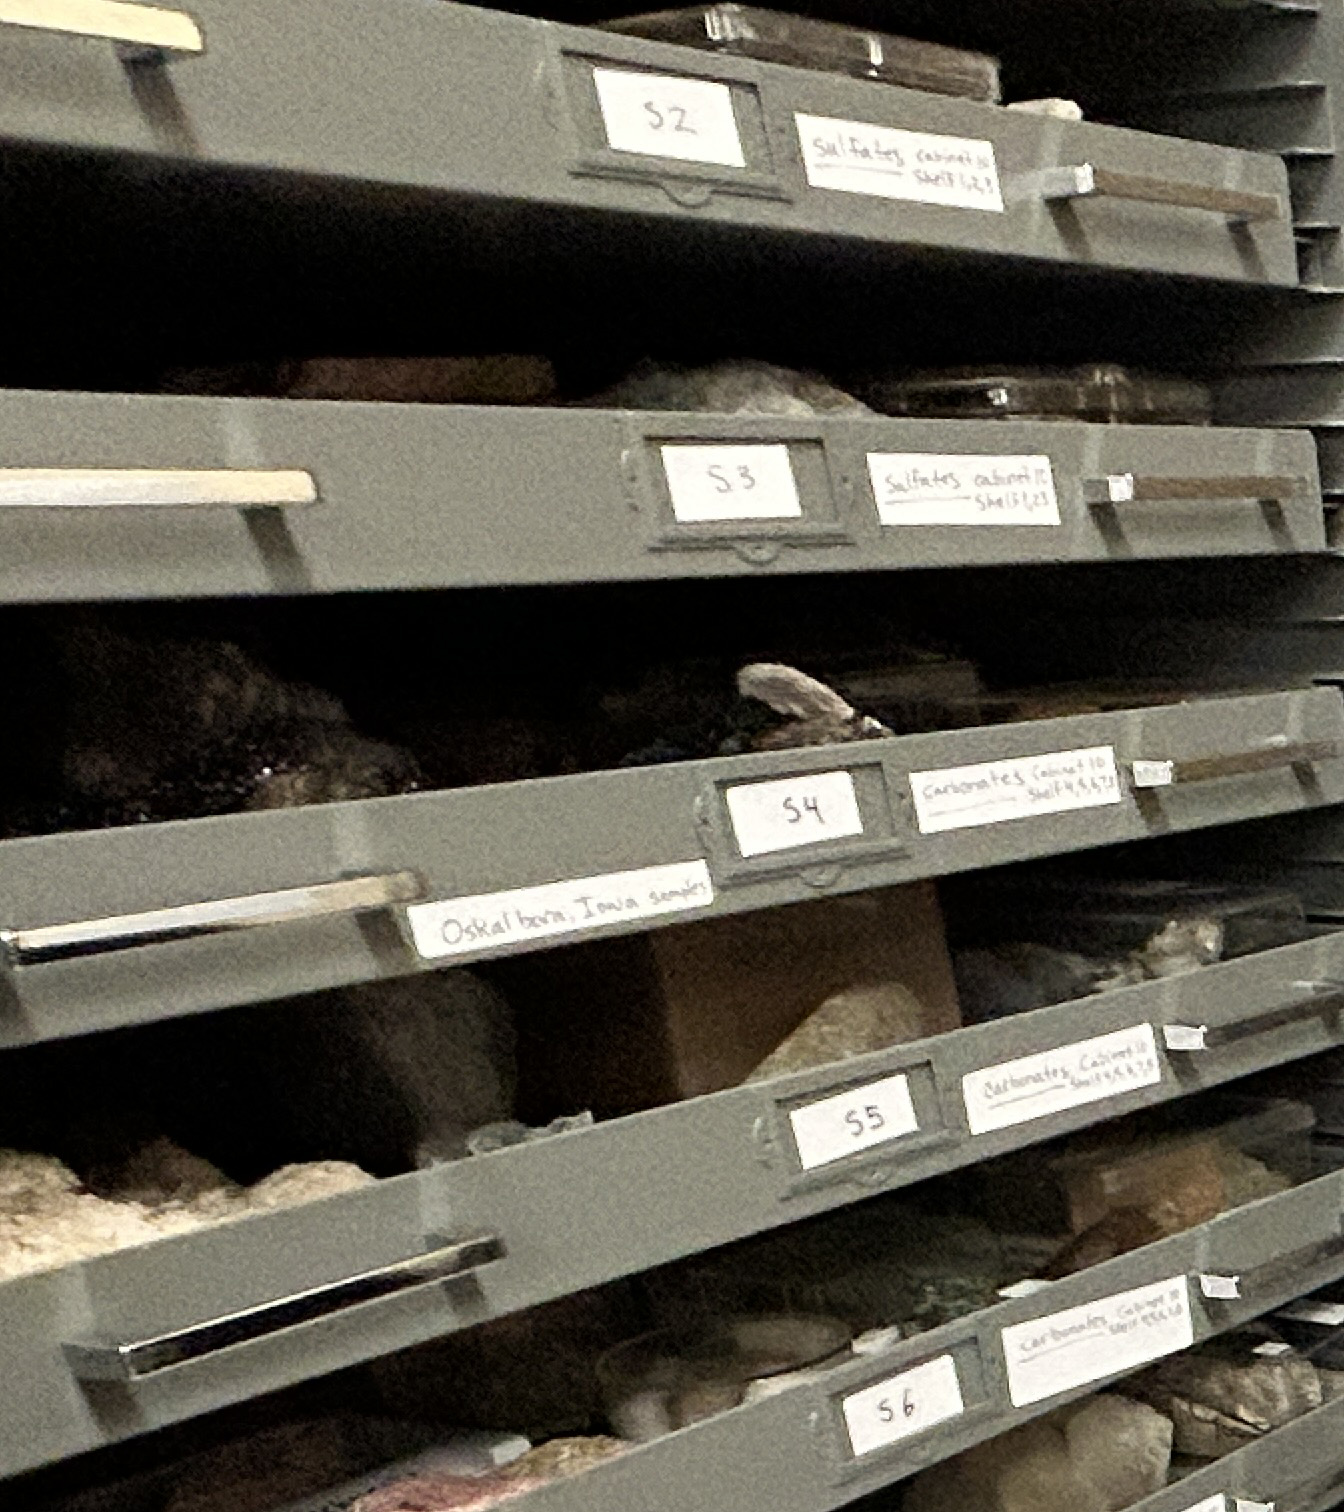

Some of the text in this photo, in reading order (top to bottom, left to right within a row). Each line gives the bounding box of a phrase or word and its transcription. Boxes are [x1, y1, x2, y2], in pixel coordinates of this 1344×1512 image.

[643, 100, 698, 135] S2
[708, 463, 756, 494] S3
[782, 795, 826, 826] S4
[844, 1103, 886, 1137] S5
